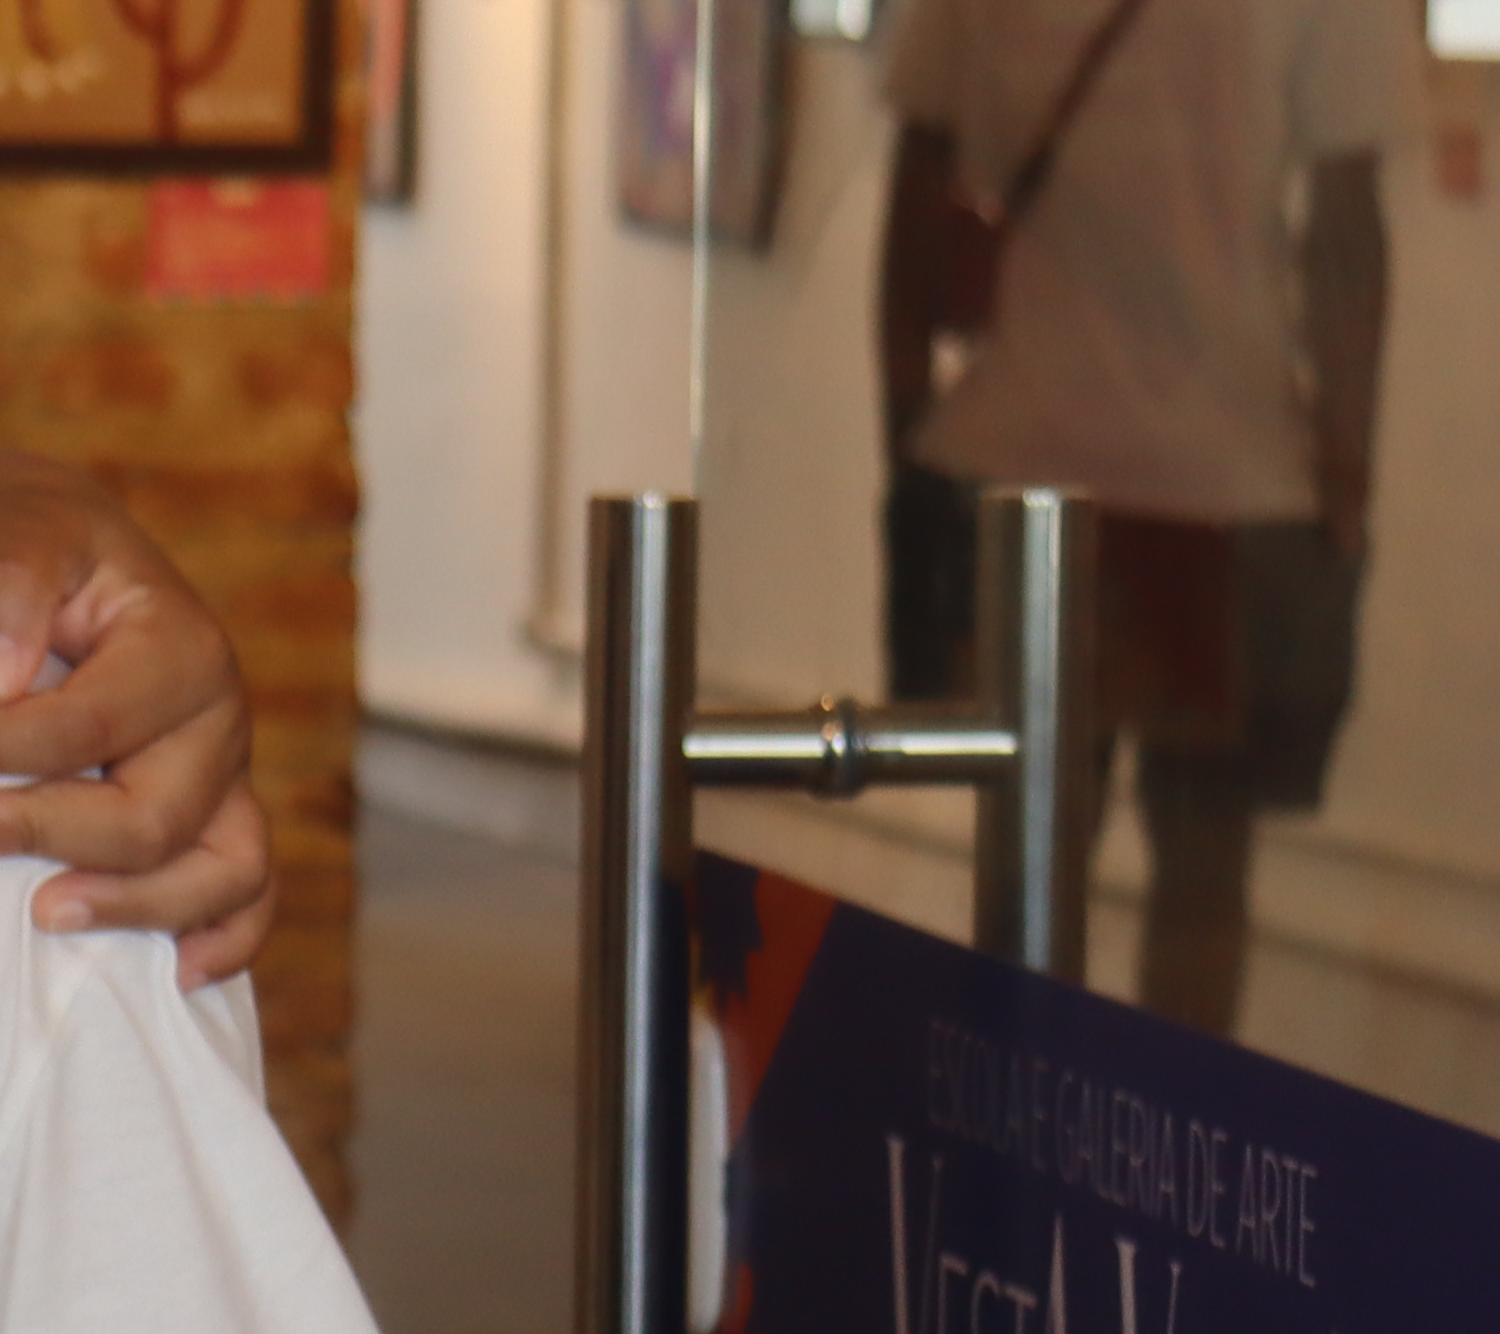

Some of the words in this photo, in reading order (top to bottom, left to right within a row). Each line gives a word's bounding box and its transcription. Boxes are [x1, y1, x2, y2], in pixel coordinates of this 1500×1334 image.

[1055, 1067, 1179, 1231] GALERIA
[1185, 1115, 1229, 1251] DE
[1235, 1142, 1319, 1289] ARTE
